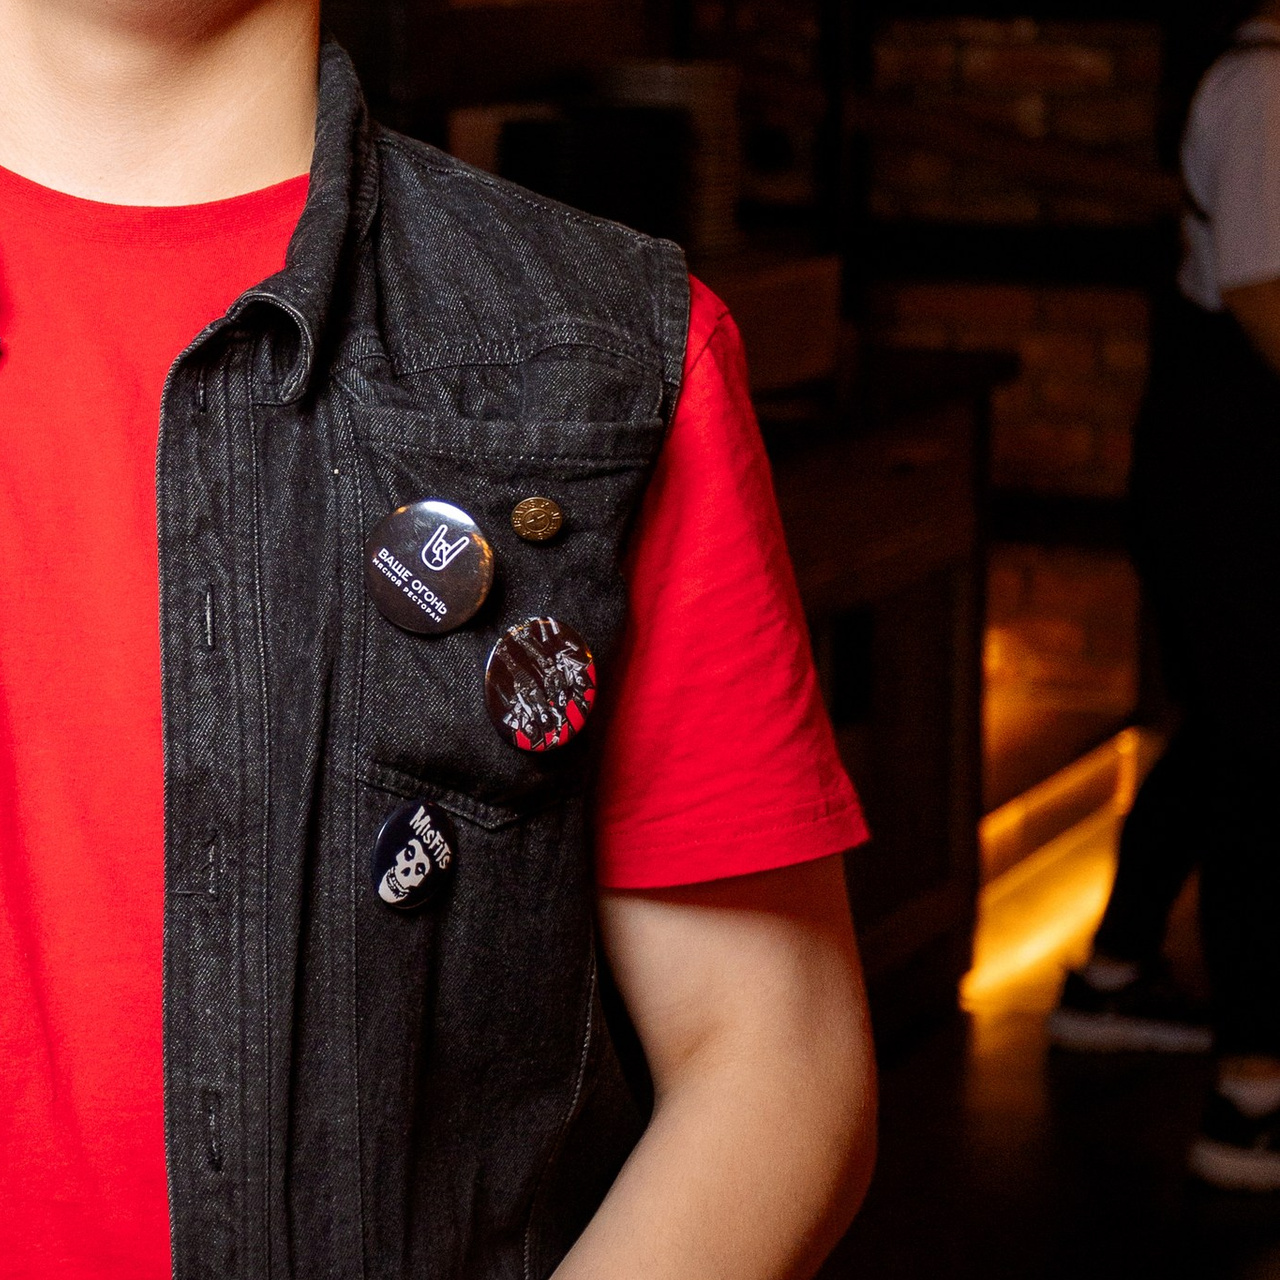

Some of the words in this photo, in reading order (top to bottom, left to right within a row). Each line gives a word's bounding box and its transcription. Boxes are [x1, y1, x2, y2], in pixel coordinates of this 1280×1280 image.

[372, 557, 403, 587] МЯСНОЙ
[402, 586, 442, 623] РЕСТОРАН
[411, 579, 448, 615] ОГОНЬ
